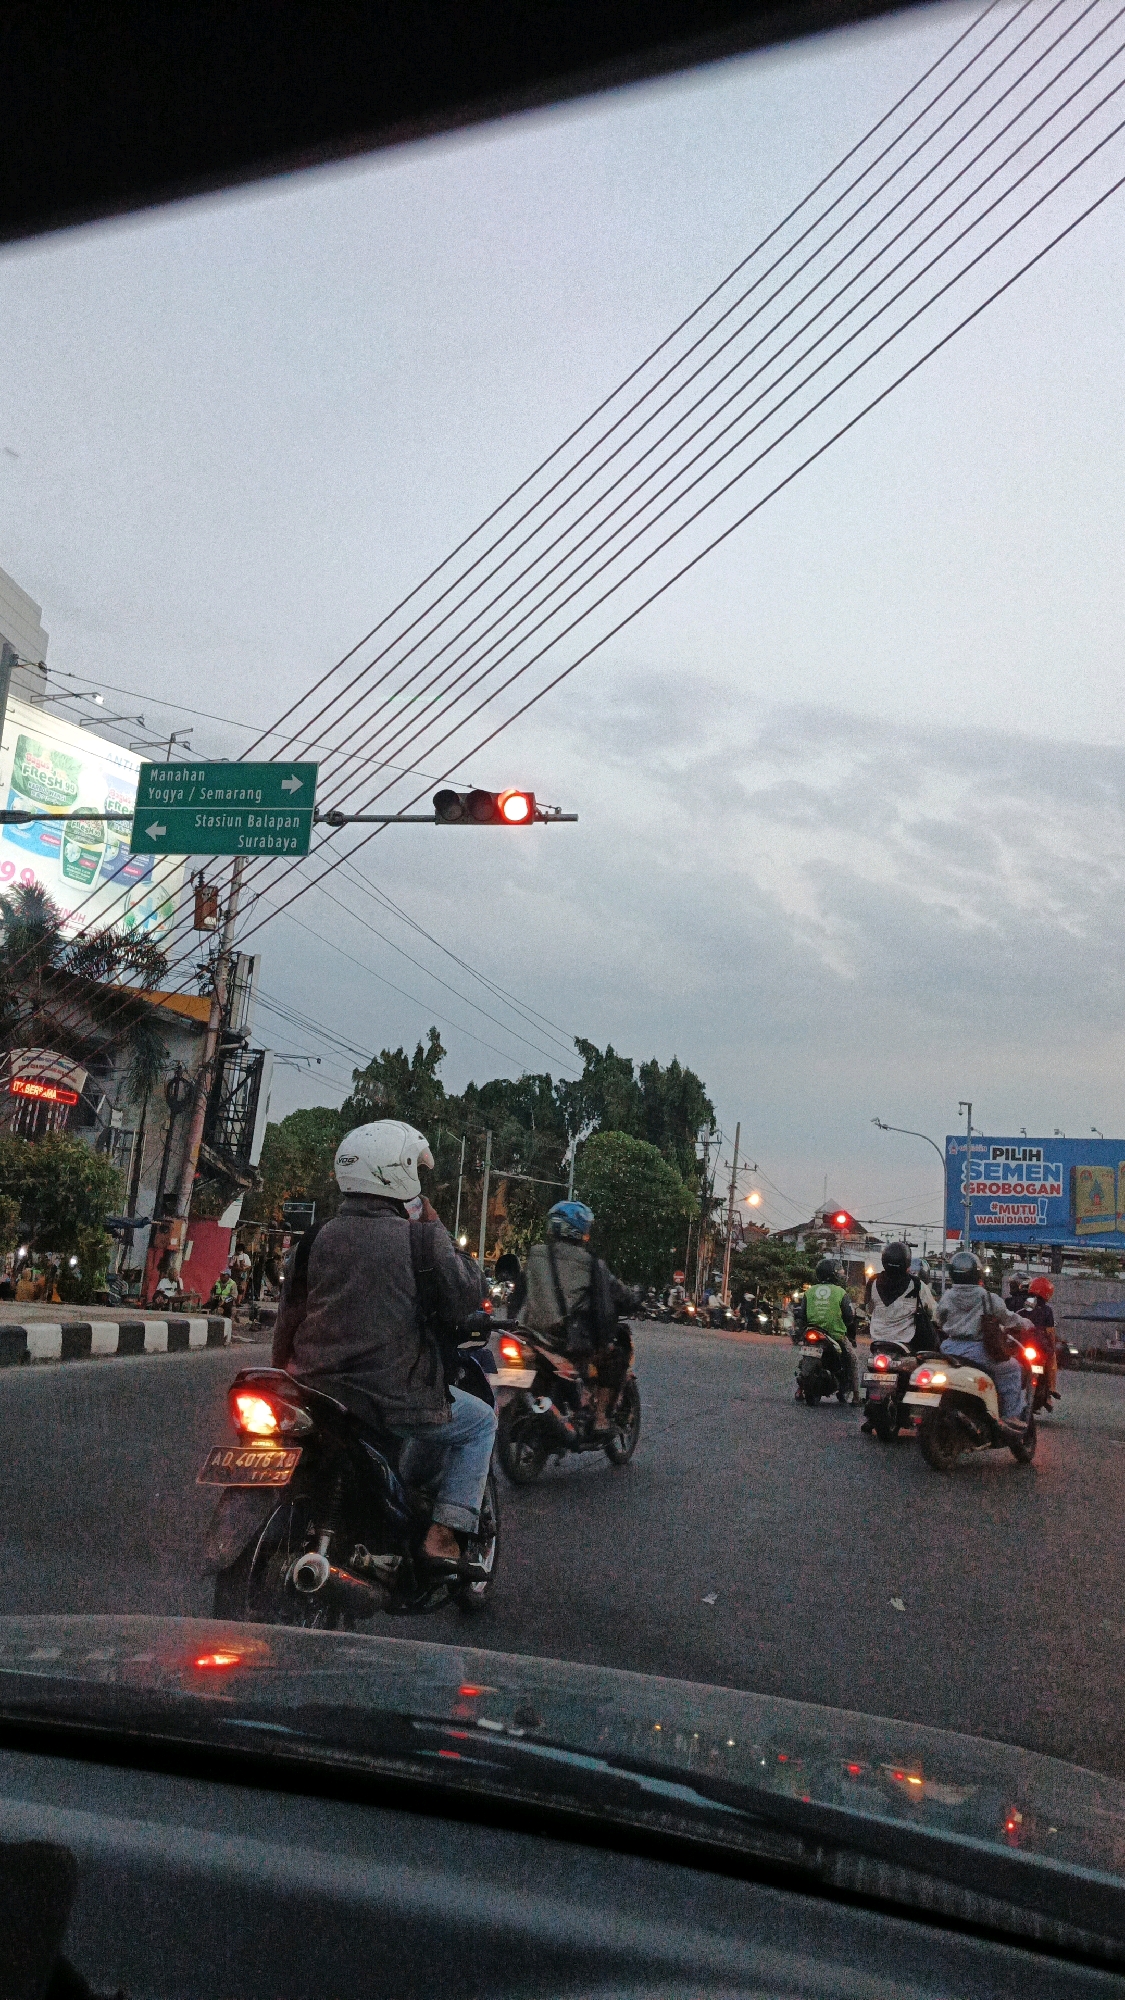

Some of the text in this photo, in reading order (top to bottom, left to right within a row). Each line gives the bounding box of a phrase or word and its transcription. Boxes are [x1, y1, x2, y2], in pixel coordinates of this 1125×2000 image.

[150, 768, 205, 782] Manahan
[148, 786, 262, 803] Yogya / Semarang
[195, 813, 300, 831] Stasiun Balapan
[238, 834, 297, 851] Surabaya
[992, 1147, 1042, 1162] PILIH
[964, 1162, 1062, 1182] SEMEN
[963, 1182, 1061, 1195] GROBOGAN
[991, 1202, 1036, 1215] #MUTU
[976, 1215, 1005, 1225] WANI
[1006, 1216, 1036, 1224] DIADU
[211, 1452, 234, 1467] AD
[235, 1452, 275, 1468] 4076
